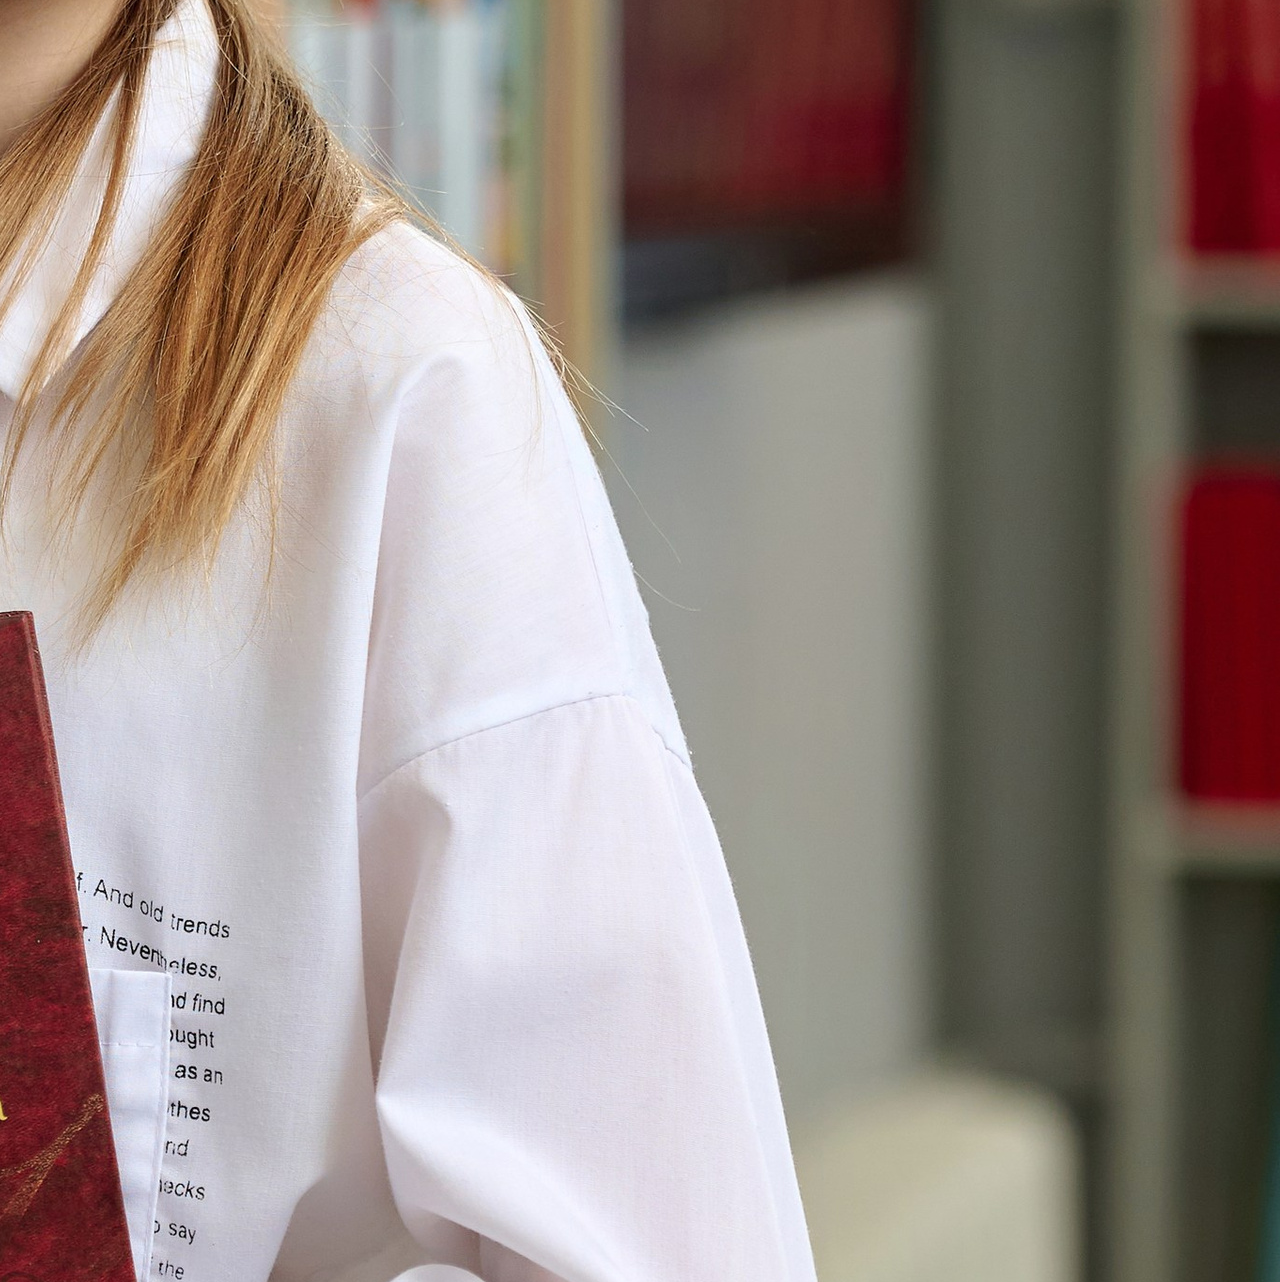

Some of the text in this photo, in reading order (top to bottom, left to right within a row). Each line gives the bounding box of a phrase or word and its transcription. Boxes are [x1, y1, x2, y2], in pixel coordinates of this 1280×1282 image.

[93, 879, 134, 909] And
[139, 900, 164, 923] old
[170, 913, 231, 939] trends
[100, 925, 221, 982] Nevertheless,
[192, 993, 225, 1015] find
[174, 1064, 223, 1085] as an
[168, 1222, 197, 1246] say
[158, 1260, 185, 1280] the
